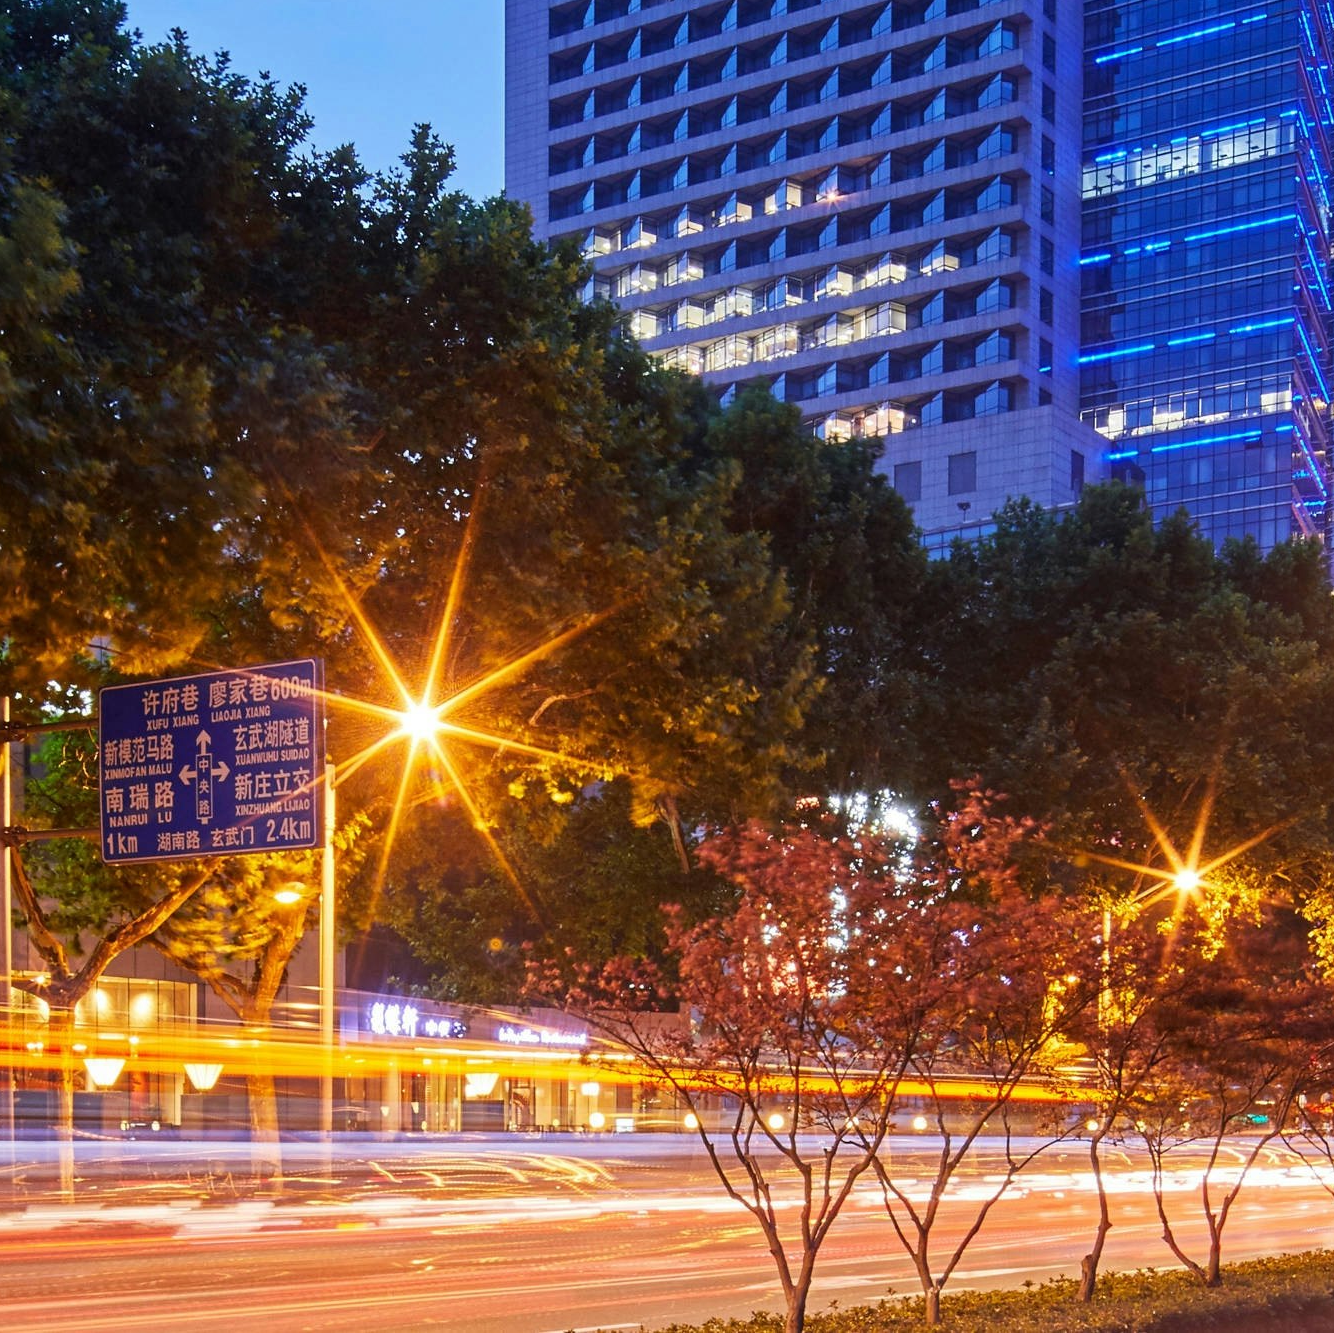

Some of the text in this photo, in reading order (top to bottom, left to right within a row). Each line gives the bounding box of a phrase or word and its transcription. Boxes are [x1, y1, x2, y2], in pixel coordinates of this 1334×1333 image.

[142, 674, 312, 716] 许府巷 廖家巷 600m
[147, 705, 271, 732] XUFU XIANG LIAOJIA XIANG
[233, 716, 310, 752] 玄武湖隧道
[105, 733, 174, 766] 新模范马路
[235, 747, 310, 766] XUANWUHU SUIDAO
[105, 762, 173, 781] XINMOFAN MALU
[234, 766, 311, 802] 新庄立交
[198, 758, 210, 815] 中央路
[109, 811, 173, 828] NANRUI LU
[235, 798, 311, 817] XINZHUANG LIJIAO
[157, 825, 255, 852] 湖南路 玄武门
[266, 816, 311, 842] 2.4km
